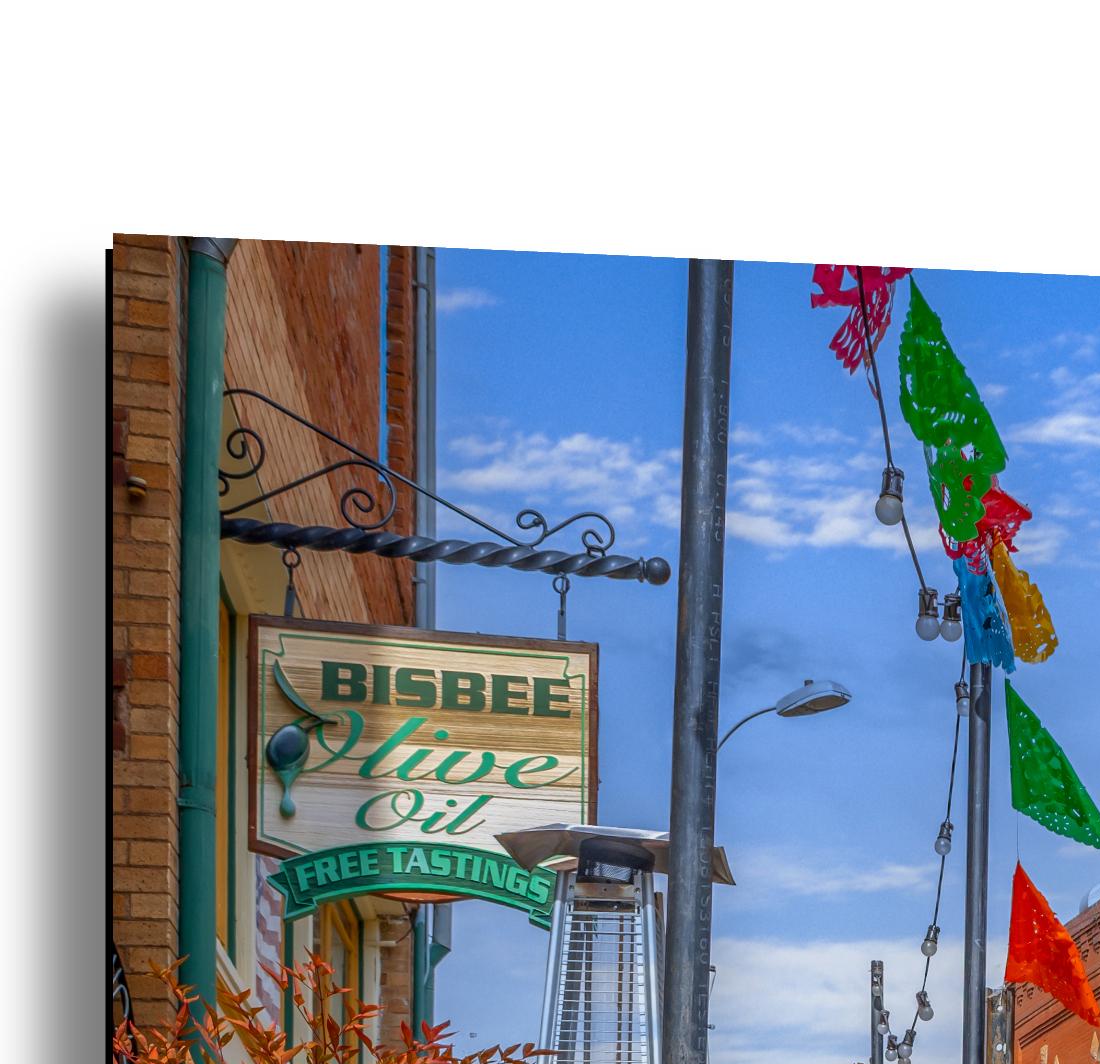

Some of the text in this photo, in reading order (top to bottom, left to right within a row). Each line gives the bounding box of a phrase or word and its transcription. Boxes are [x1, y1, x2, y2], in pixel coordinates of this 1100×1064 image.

[320, 660, 572, 718] BISBEE
[354, 788, 495, 836] Oil
[294, 846, 552, 905] FREE TASTINGS
